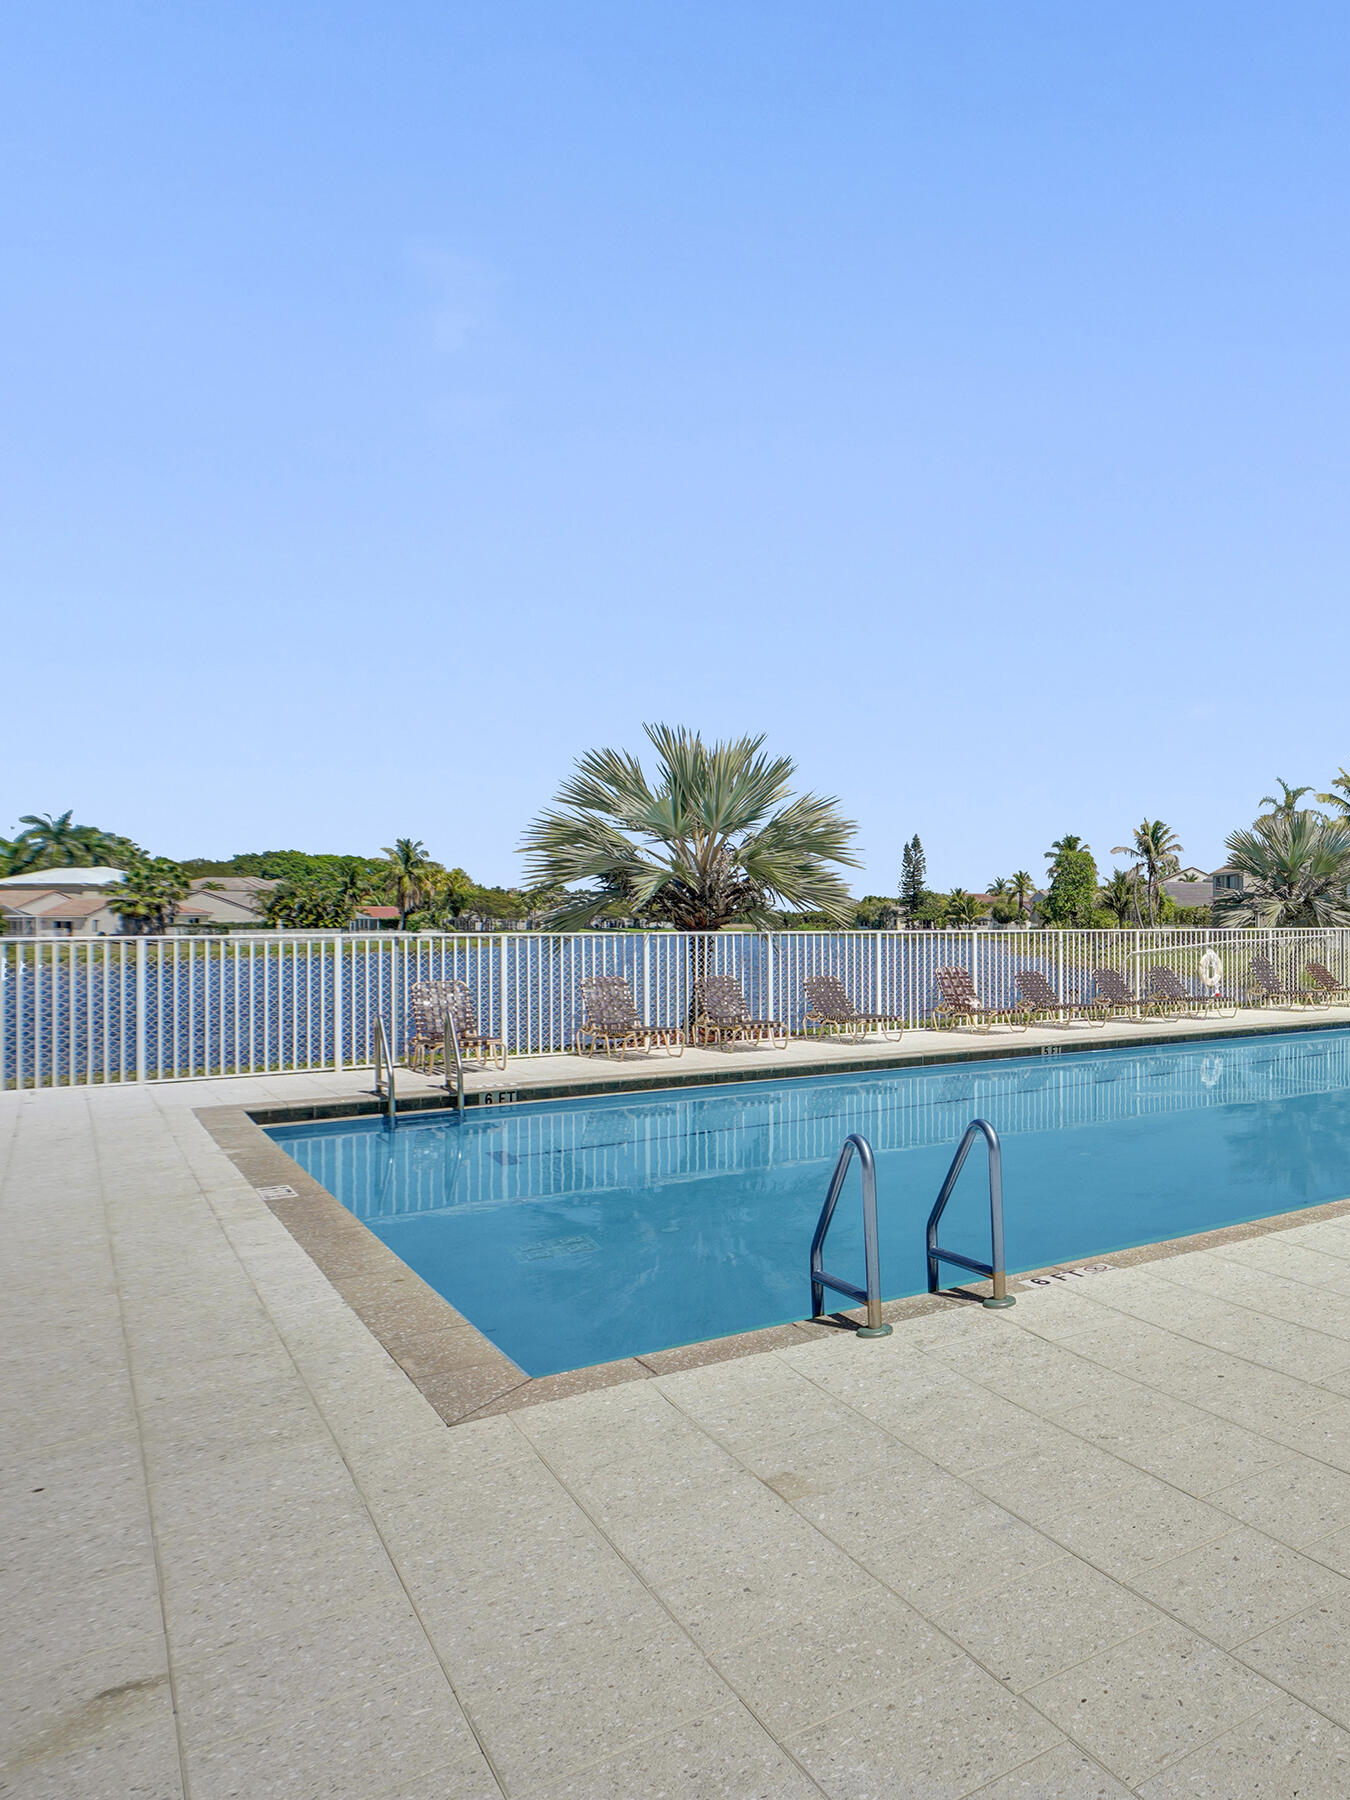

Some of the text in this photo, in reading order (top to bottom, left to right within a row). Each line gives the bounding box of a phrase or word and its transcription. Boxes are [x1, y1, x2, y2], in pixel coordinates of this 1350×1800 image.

[485, 1091, 516, 1104] 6 FT
[1051, 1270, 1084, 1281] FT
